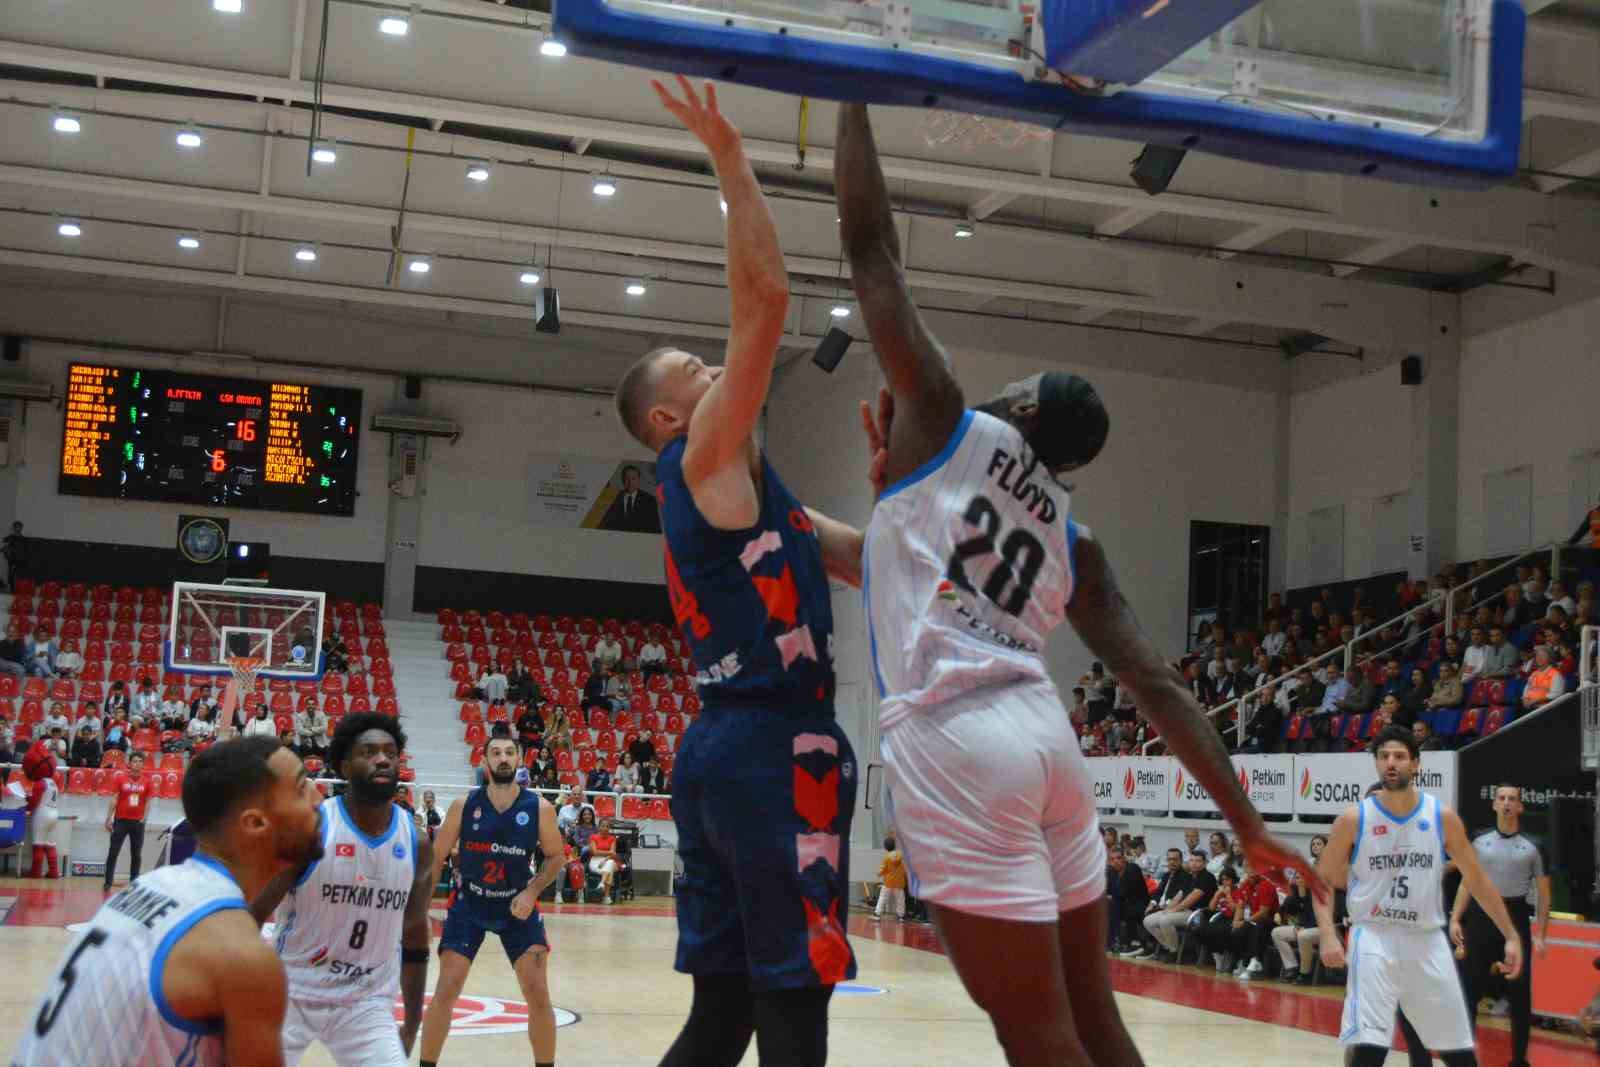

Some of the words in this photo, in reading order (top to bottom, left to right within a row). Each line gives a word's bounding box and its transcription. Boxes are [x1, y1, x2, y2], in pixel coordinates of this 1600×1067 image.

[237, 420, 255, 441] 16
[212, 450, 225, 472] 6
[987, 448, 1056, 524] FLOYD
[947, 495, 1045, 618] 20
[1137, 770, 1164, 785] Petkim
[1252, 769, 1286, 787] Petkim
[1412, 768, 1442, 788] tkim
[1094, 782, 1113, 799] CAR
[1186, 783, 1210, 800] SOC
[1314, 783, 1360, 803] SOCAR
[1390, 876, 1409, 899] 15
[1382, 907, 1418, 921] STAR
[348, 919, 369, 950] 8
[35, 927, 109, 1038] 5
